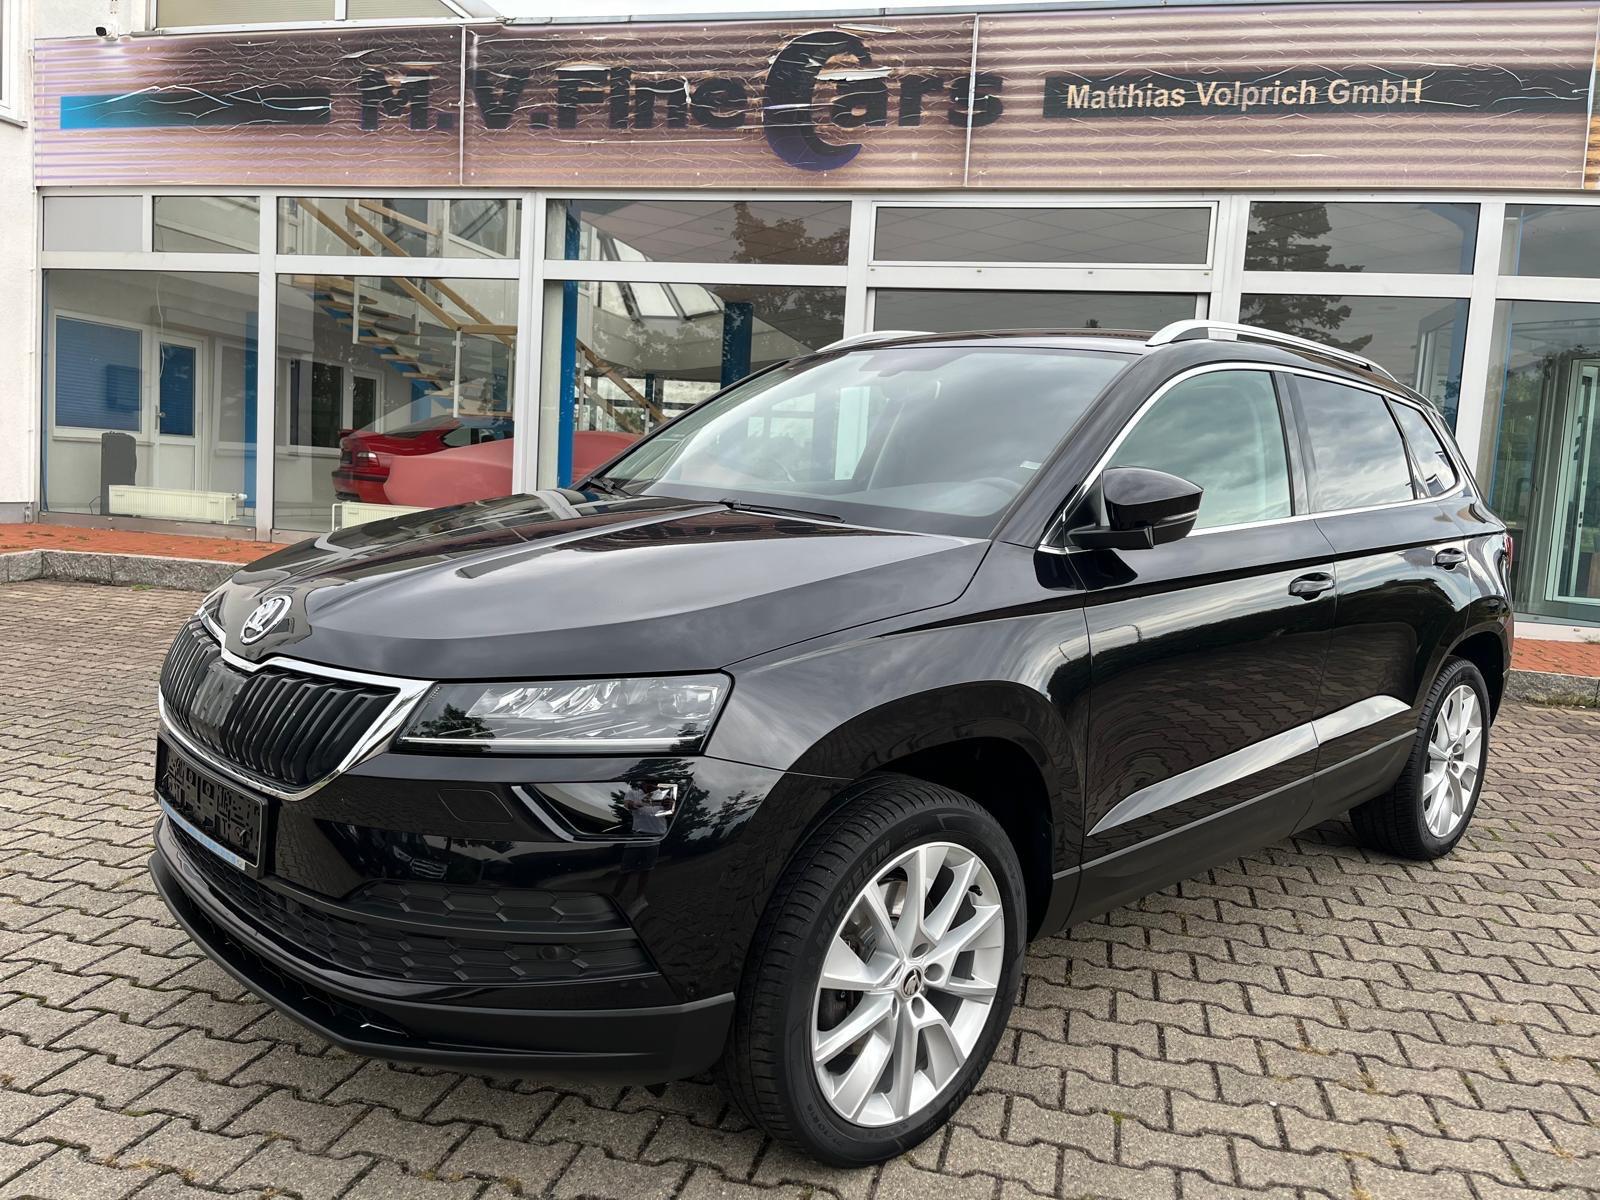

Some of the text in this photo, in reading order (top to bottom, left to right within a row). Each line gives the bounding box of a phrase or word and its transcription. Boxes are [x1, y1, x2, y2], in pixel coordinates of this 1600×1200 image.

[1066, 78, 1422, 112] Matthias Volprich GmbH
[815, 839, 891, 947] MICHELIN
